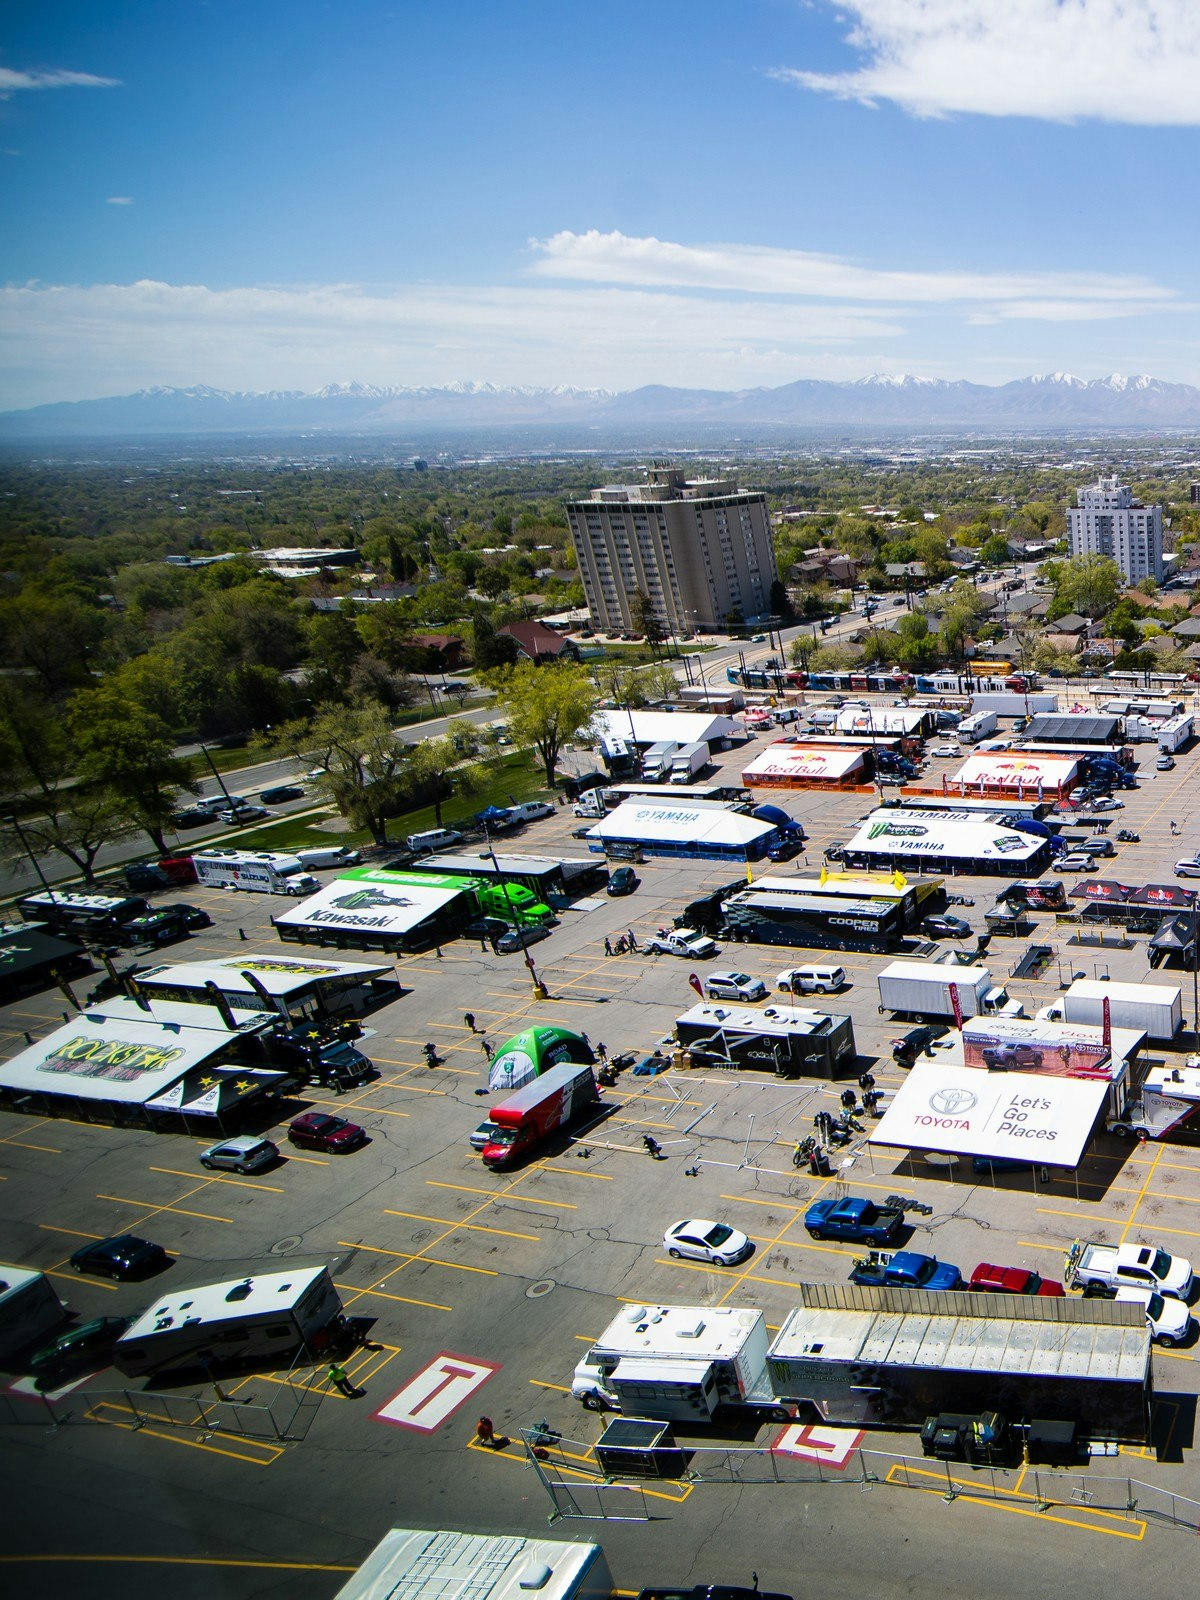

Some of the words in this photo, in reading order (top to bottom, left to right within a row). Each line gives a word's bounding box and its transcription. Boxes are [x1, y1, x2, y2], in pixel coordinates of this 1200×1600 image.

[764, 764, 798, 774] Red
[795, 766, 828, 775] Bull
[975, 773, 1010, 784] Red
[1009, 775, 1044, 785] Bull
[649, 811, 700, 823] YAMAHA
[908, 811, 970, 821] YAMAHA
[899, 841, 945, 851] YAMAHA
[241, 873, 270, 882] SUZUKI
[360, 870, 452, 885] Kawasaki
[305, 909, 398, 927] Kawasaki
[828, 917, 879, 928] COOPER
[963, 1036, 998, 1044] TACOMA
[56, 1036, 182, 1070] ROCKSTAR
[548, 1044, 568, 1058] ROAD
[1010, 1094, 1051, 1110] Let's
[1003, 1107, 1028, 1122] Go
[914, 1115, 970, 1131] TOYOTA
[996, 1121, 1058, 1141] Places
[408, 1364, 481, 1417] T
